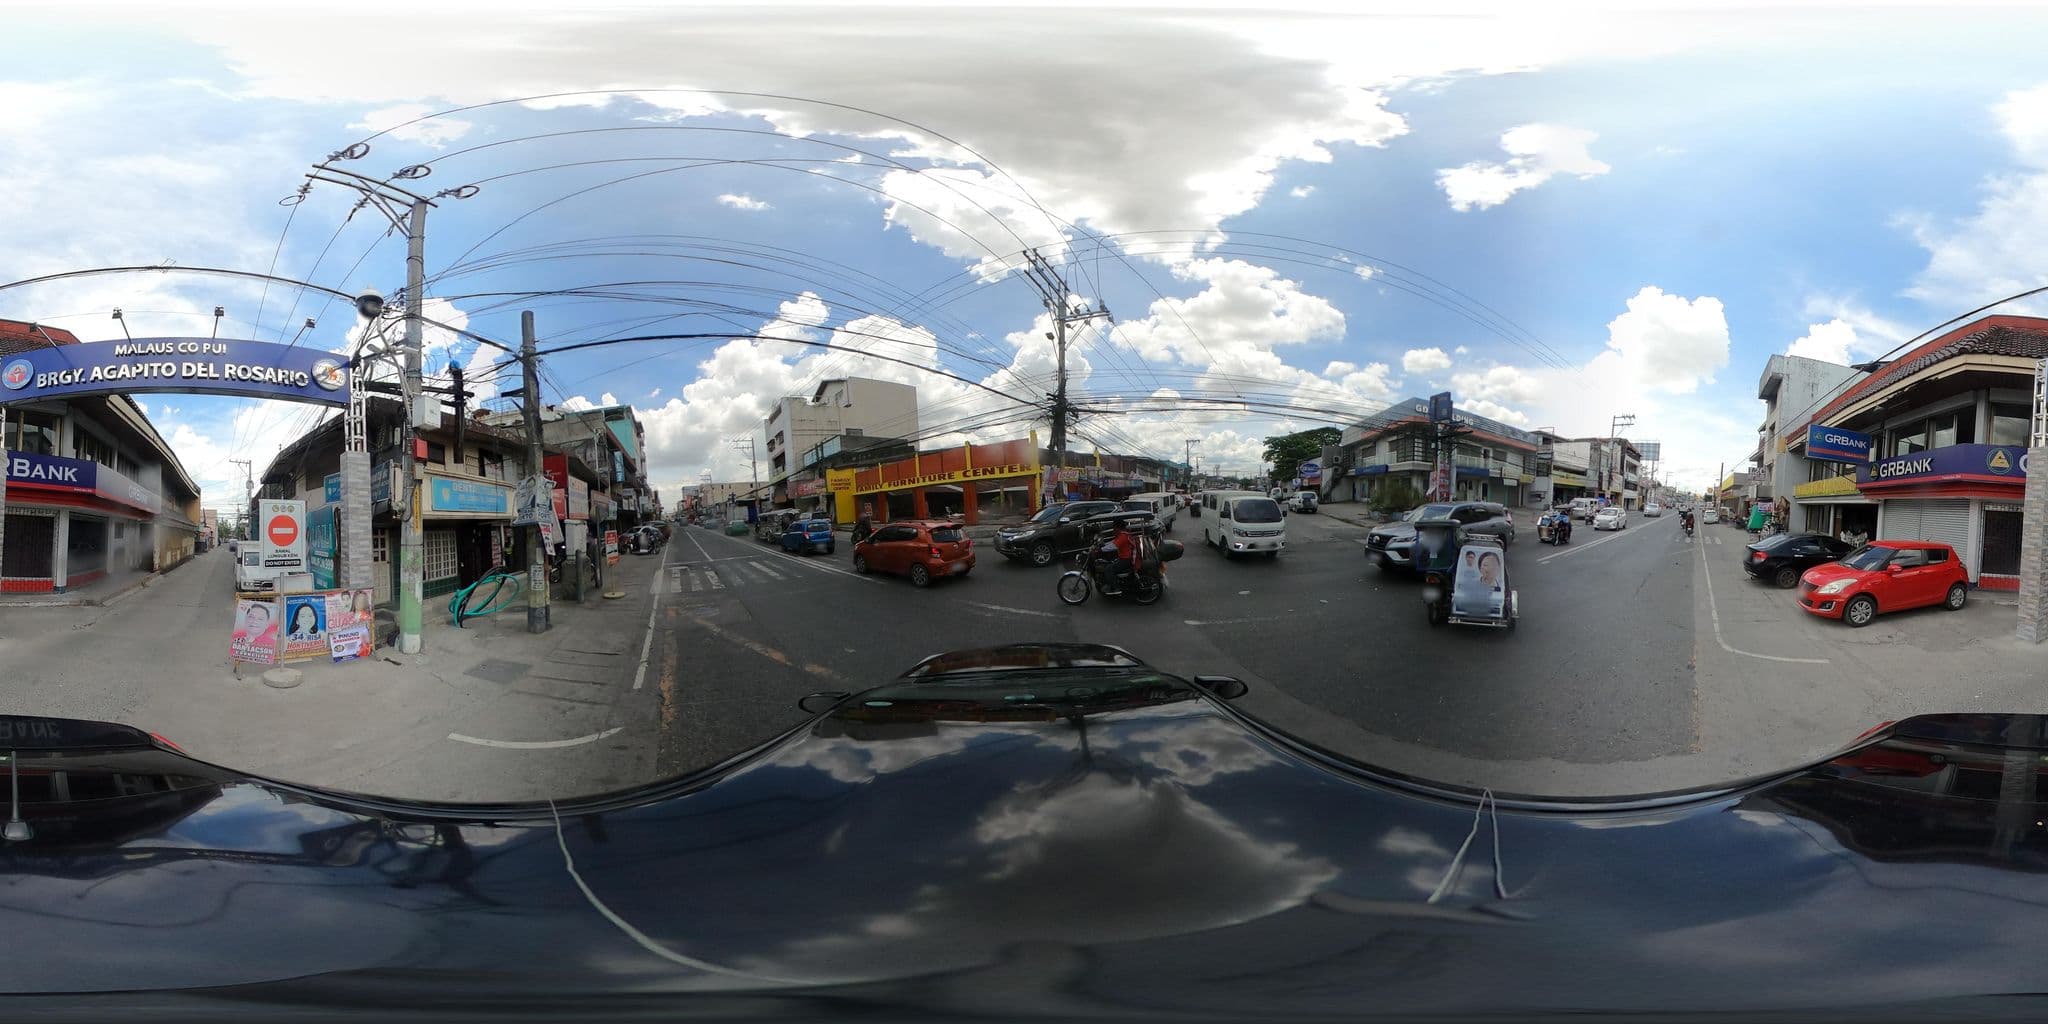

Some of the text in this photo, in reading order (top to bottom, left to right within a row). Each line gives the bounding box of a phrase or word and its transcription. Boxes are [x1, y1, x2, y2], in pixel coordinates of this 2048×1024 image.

[115, 342, 227, 356] MALAUS CO PUI
[36, 362, 309, 388] BRGY. AGAPITO DEL ROSARIO
[1452, 413, 1474, 425] LDING
[1825, 433, 1868, 449] GRBANK
[888, 473, 955, 488] FURNITURE
[962, 464, 1032, 478] CENTER
[1880, 457, 1932, 478] GRBANK
